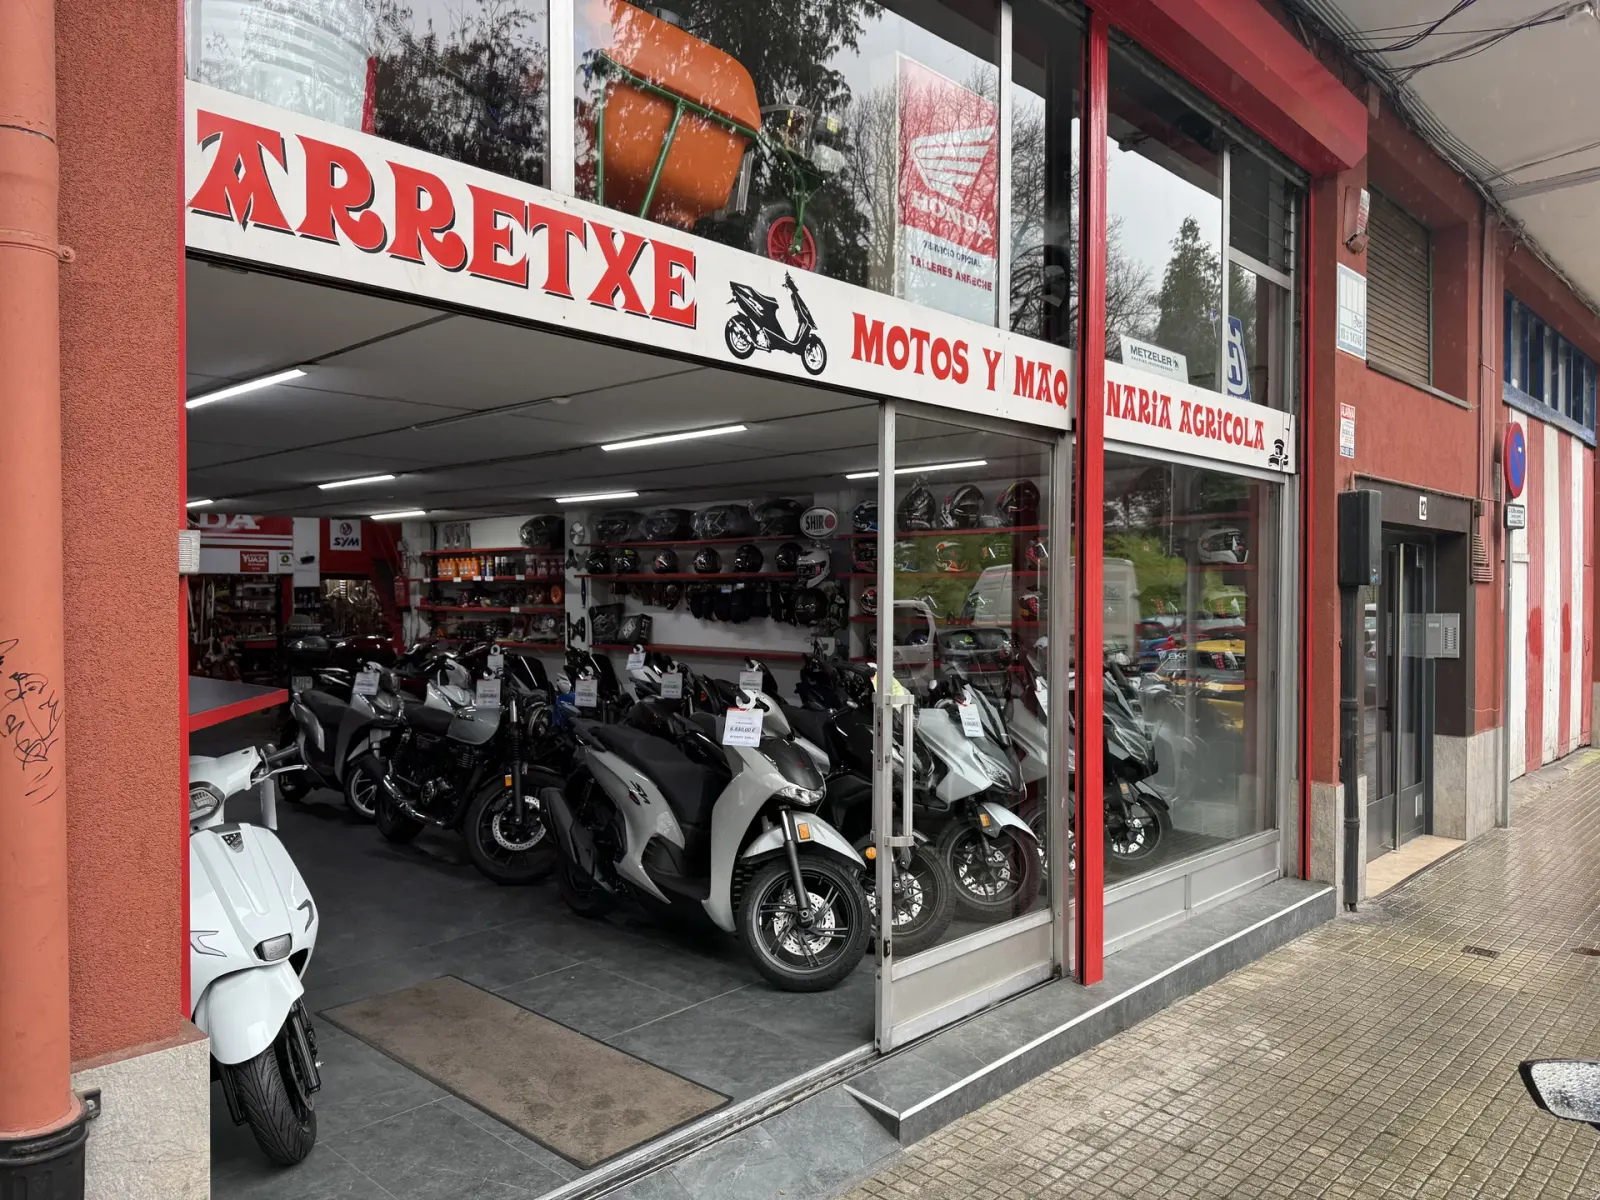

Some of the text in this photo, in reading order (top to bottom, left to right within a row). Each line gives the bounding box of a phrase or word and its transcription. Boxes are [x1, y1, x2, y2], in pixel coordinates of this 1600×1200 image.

[188, 108, 696, 329] ARRETXE
[910, 189, 993, 240] HONDA
[910, 255, 953, 278] TALLERES
[851, 312, 969, 384] MOTOS
[982, 348, 1003, 391] Y
[1130, 344, 1172, 367] METZELER
[333, 537, 359, 547] SYM
